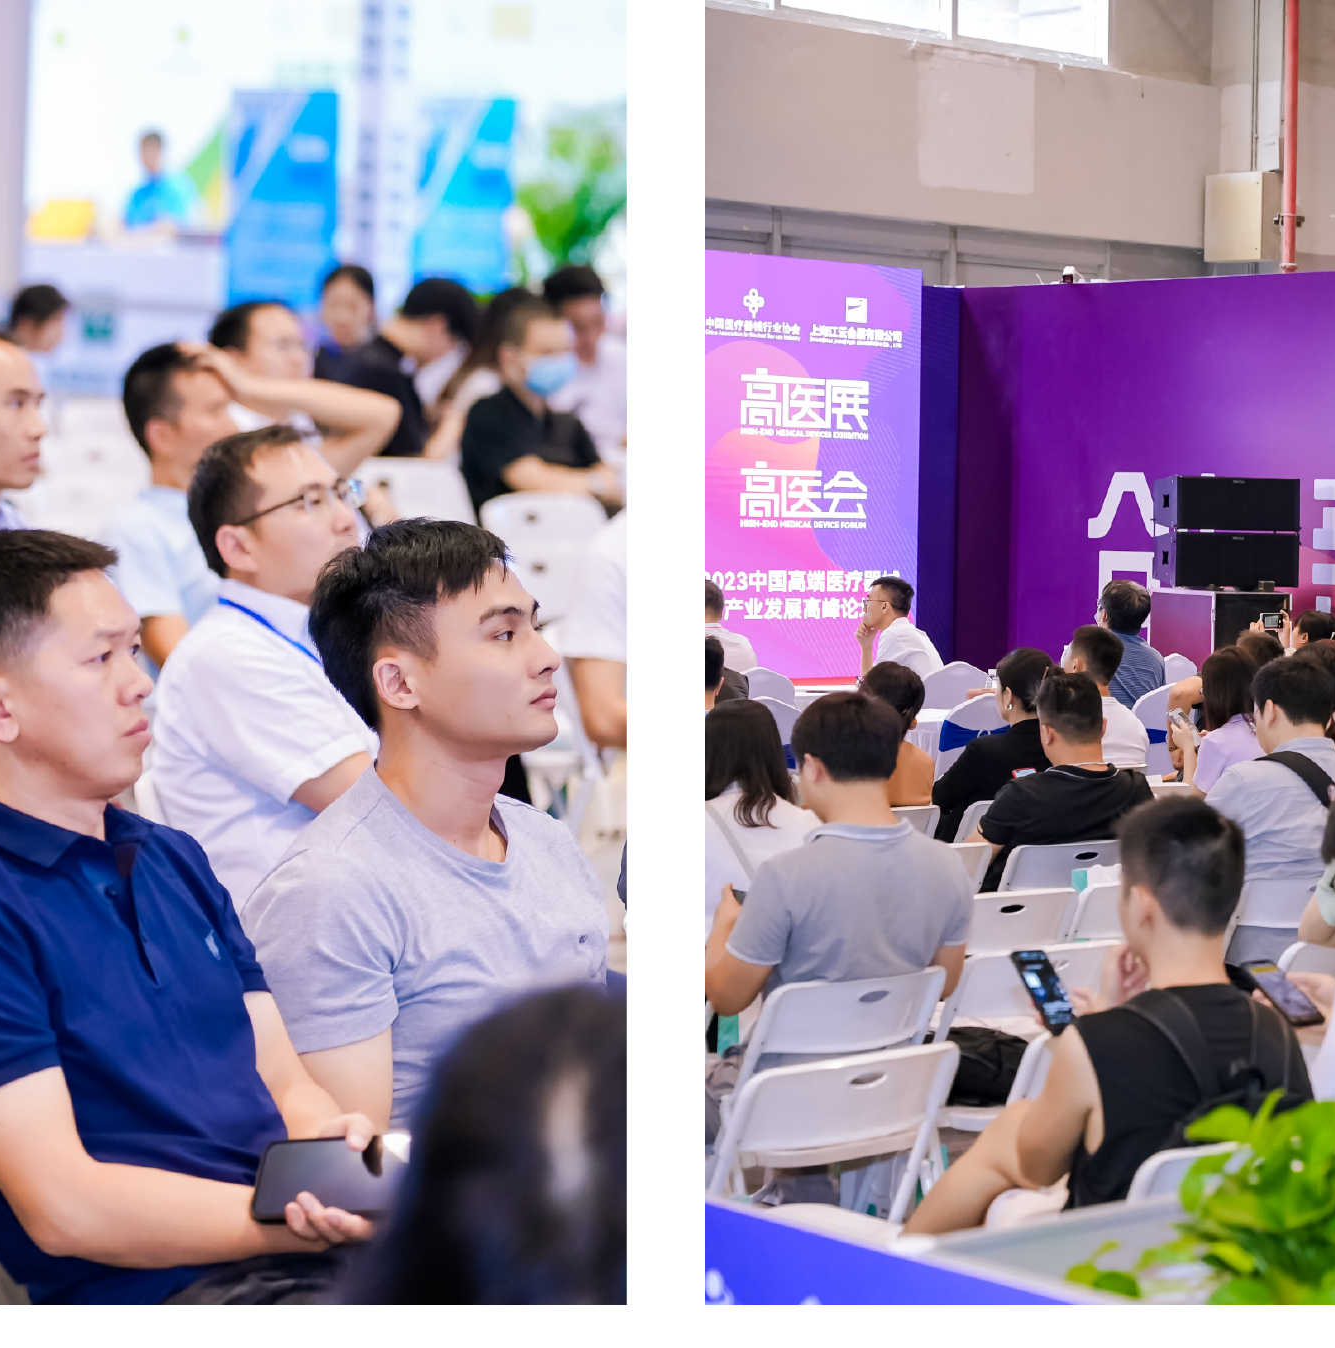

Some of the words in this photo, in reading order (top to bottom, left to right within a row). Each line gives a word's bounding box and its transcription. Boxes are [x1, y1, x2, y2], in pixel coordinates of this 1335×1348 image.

[740, 367, 870, 430] 高医展
[740, 460, 868, 518] 高医会
